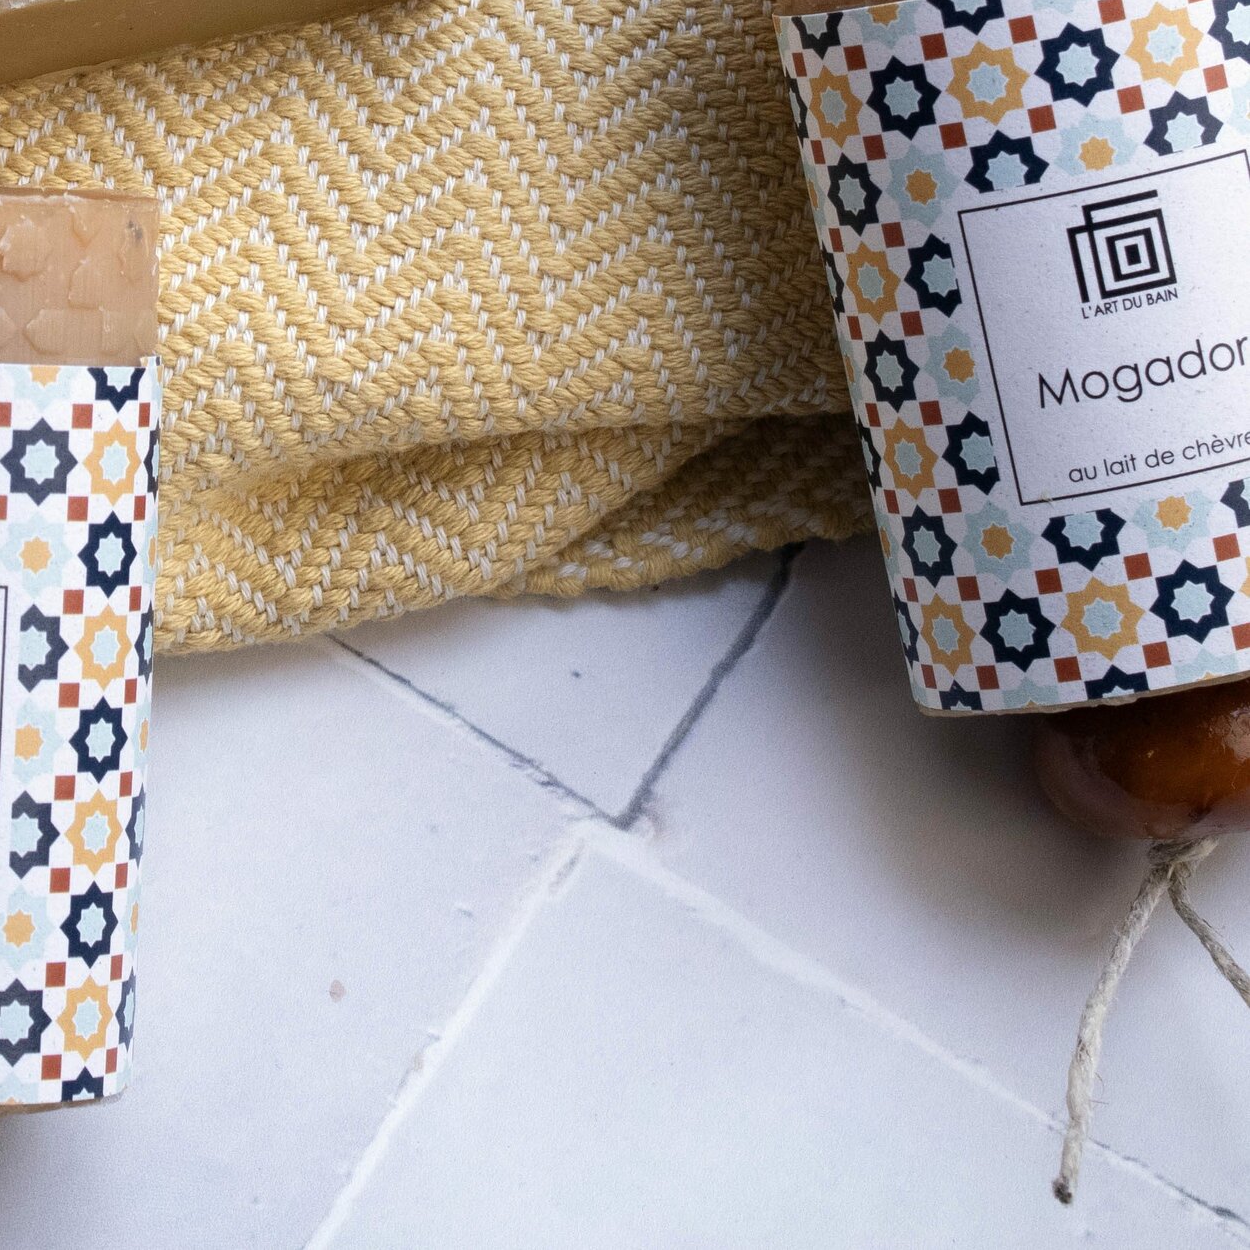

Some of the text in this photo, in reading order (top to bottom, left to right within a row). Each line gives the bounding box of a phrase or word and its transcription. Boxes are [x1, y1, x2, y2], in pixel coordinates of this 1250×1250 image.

[1081, 288, 1178, 320] L'ART DU BAIN
[1037, 336, 1248, 410] Mogador
[1068, 465, 1098, 483] au
[1103, 453, 1137, 477] lait
[1144, 448, 1175, 469] de
